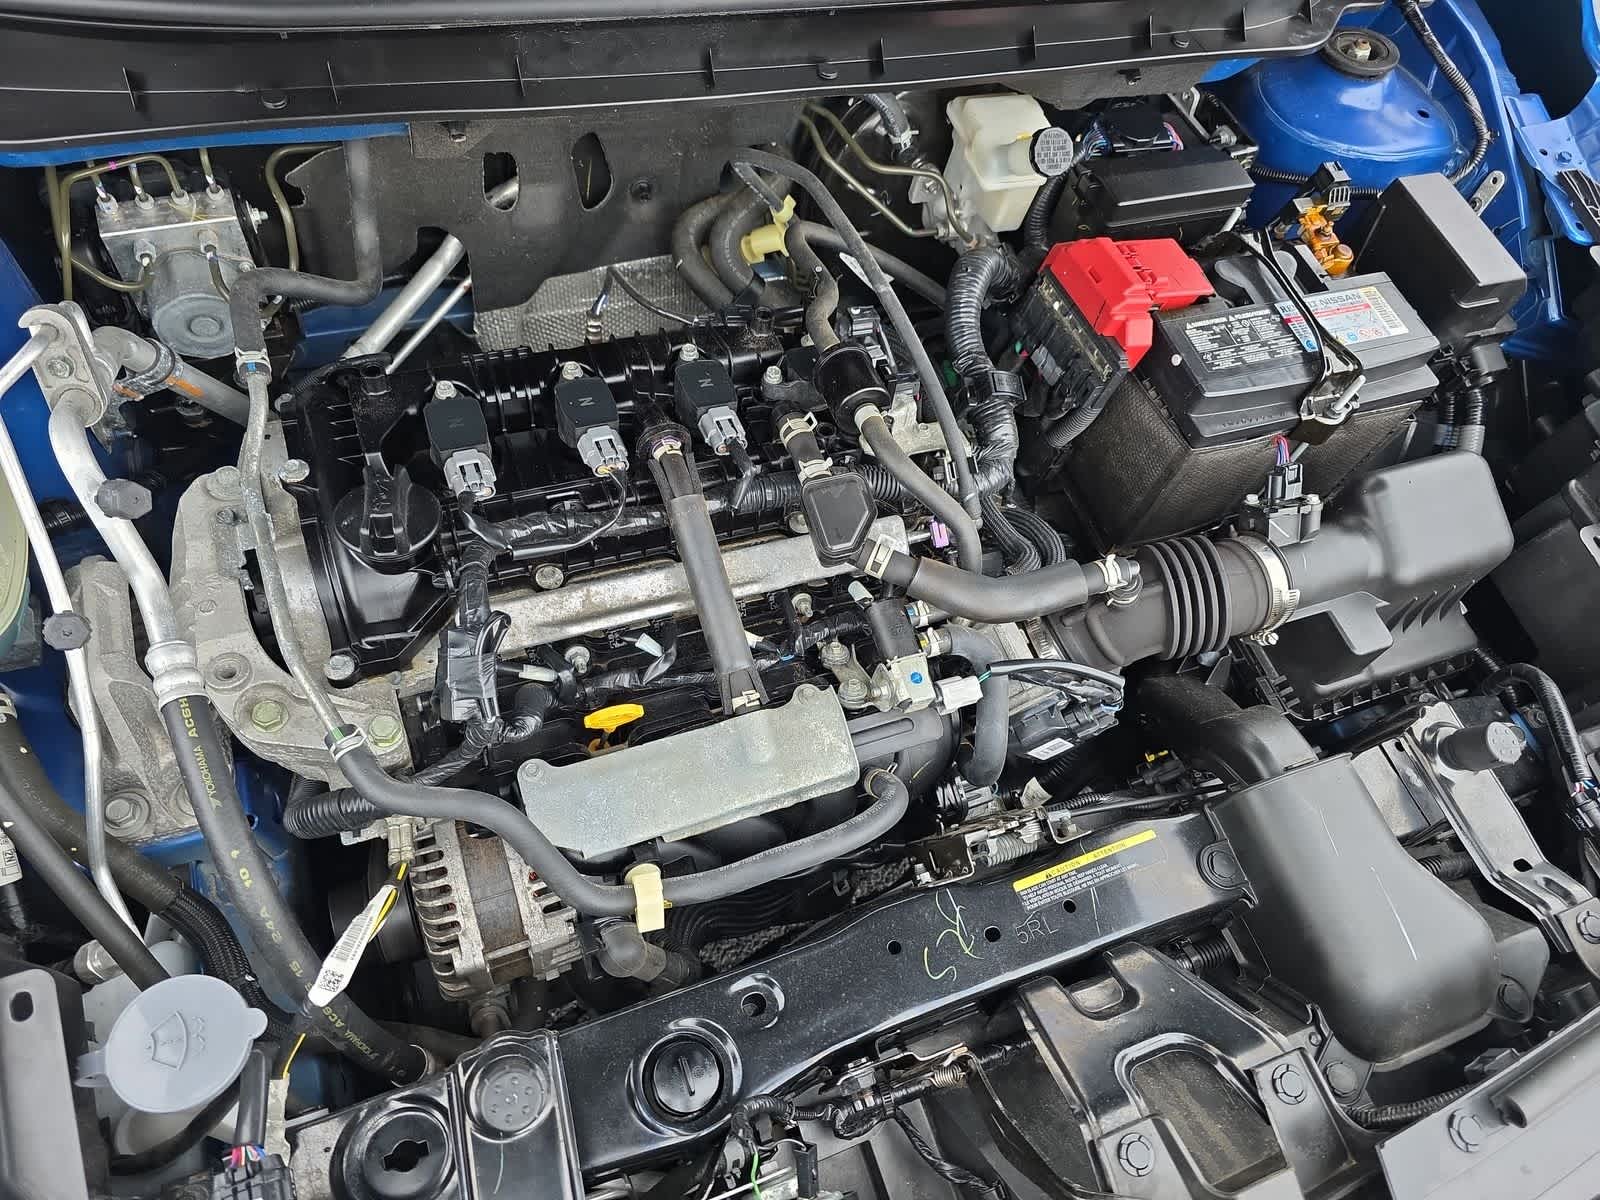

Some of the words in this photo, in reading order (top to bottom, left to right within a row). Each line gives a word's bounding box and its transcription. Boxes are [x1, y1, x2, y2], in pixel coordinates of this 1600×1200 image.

[1318, 291, 1360, 306] NISSAN
[193, 745, 216, 797] YOKOHAMA
[1050, 860, 1080, 876] CAUTION
